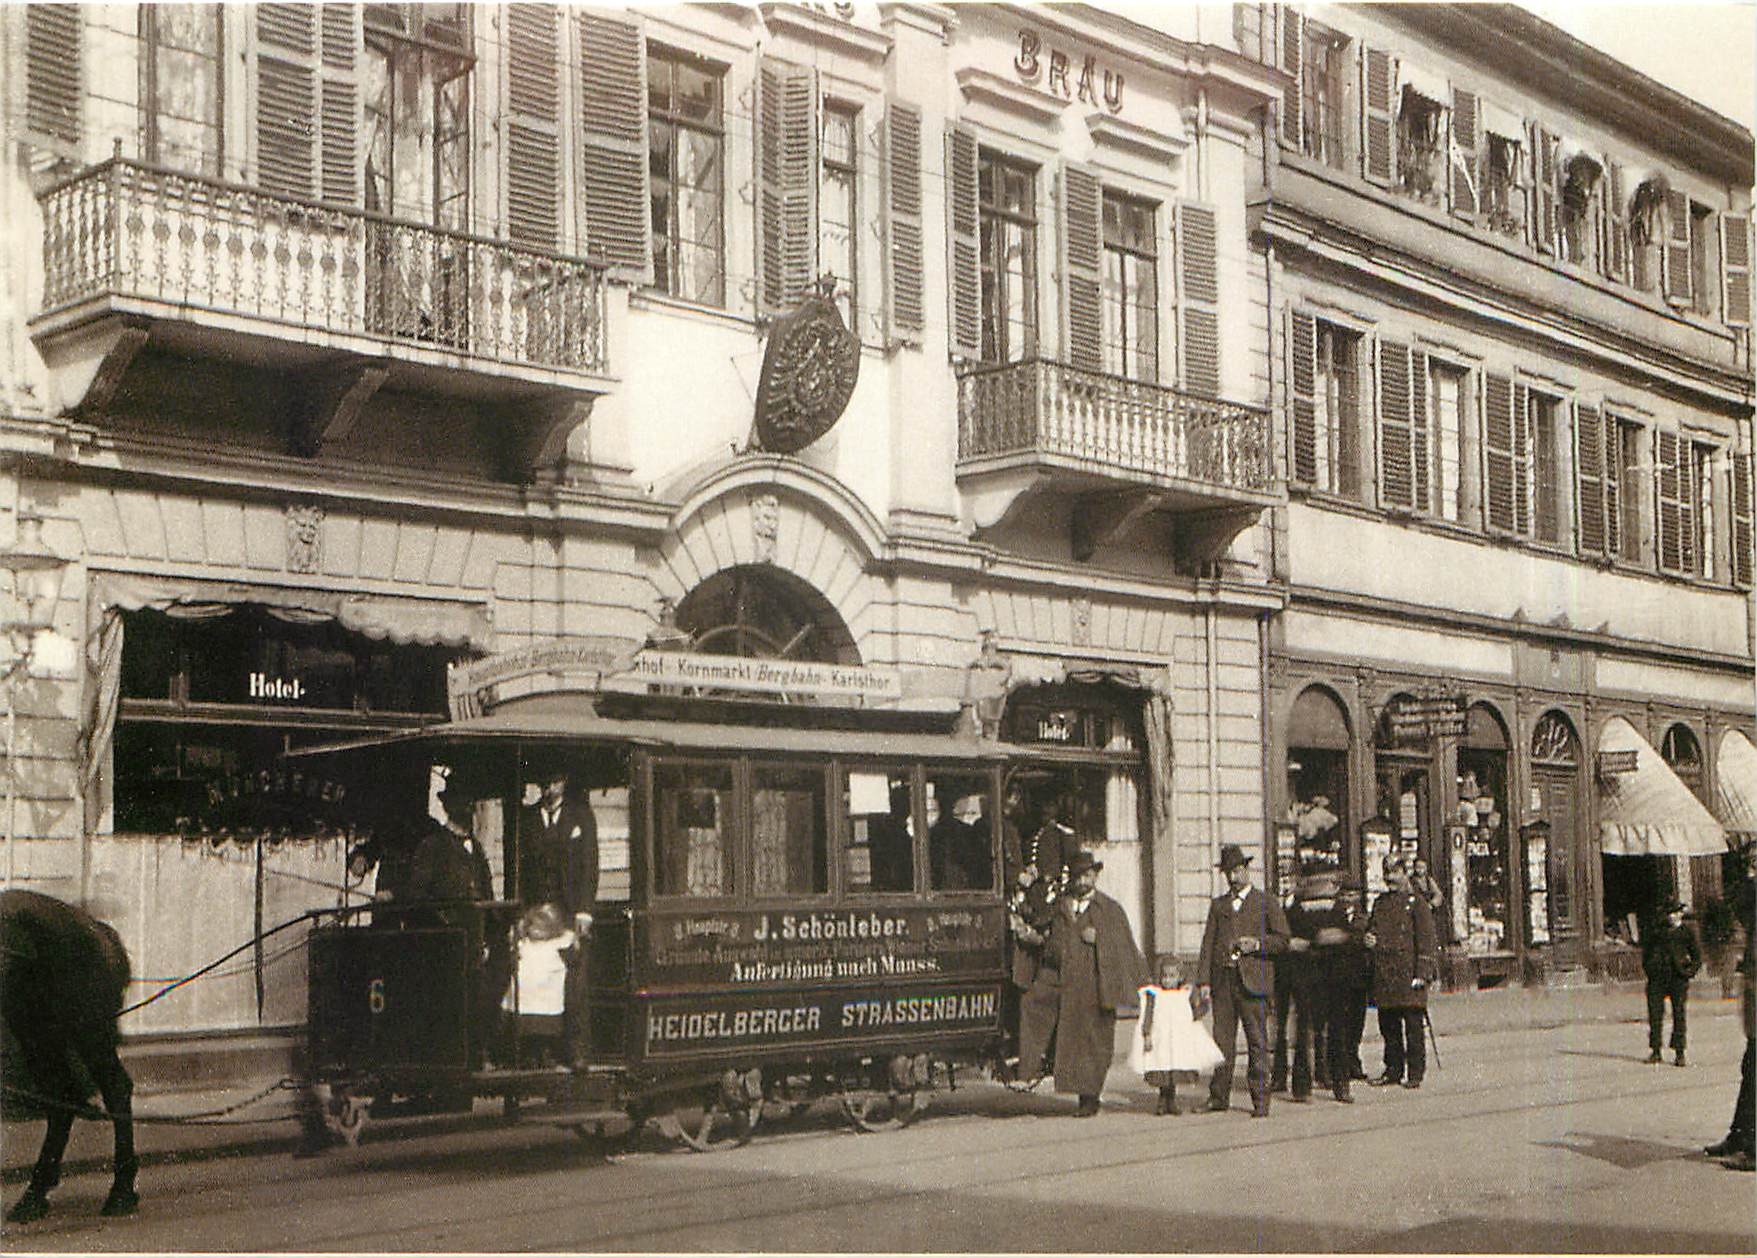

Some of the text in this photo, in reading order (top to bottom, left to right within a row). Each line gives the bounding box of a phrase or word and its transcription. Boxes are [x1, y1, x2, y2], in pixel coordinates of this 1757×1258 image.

[678, 657, 751, 681] Kornmarkt
[831, 669, 890, 690] Karlsthor
[370, 979, 384, 1013] 6
[649, 1006, 820, 1040] HEIDELBERGER
